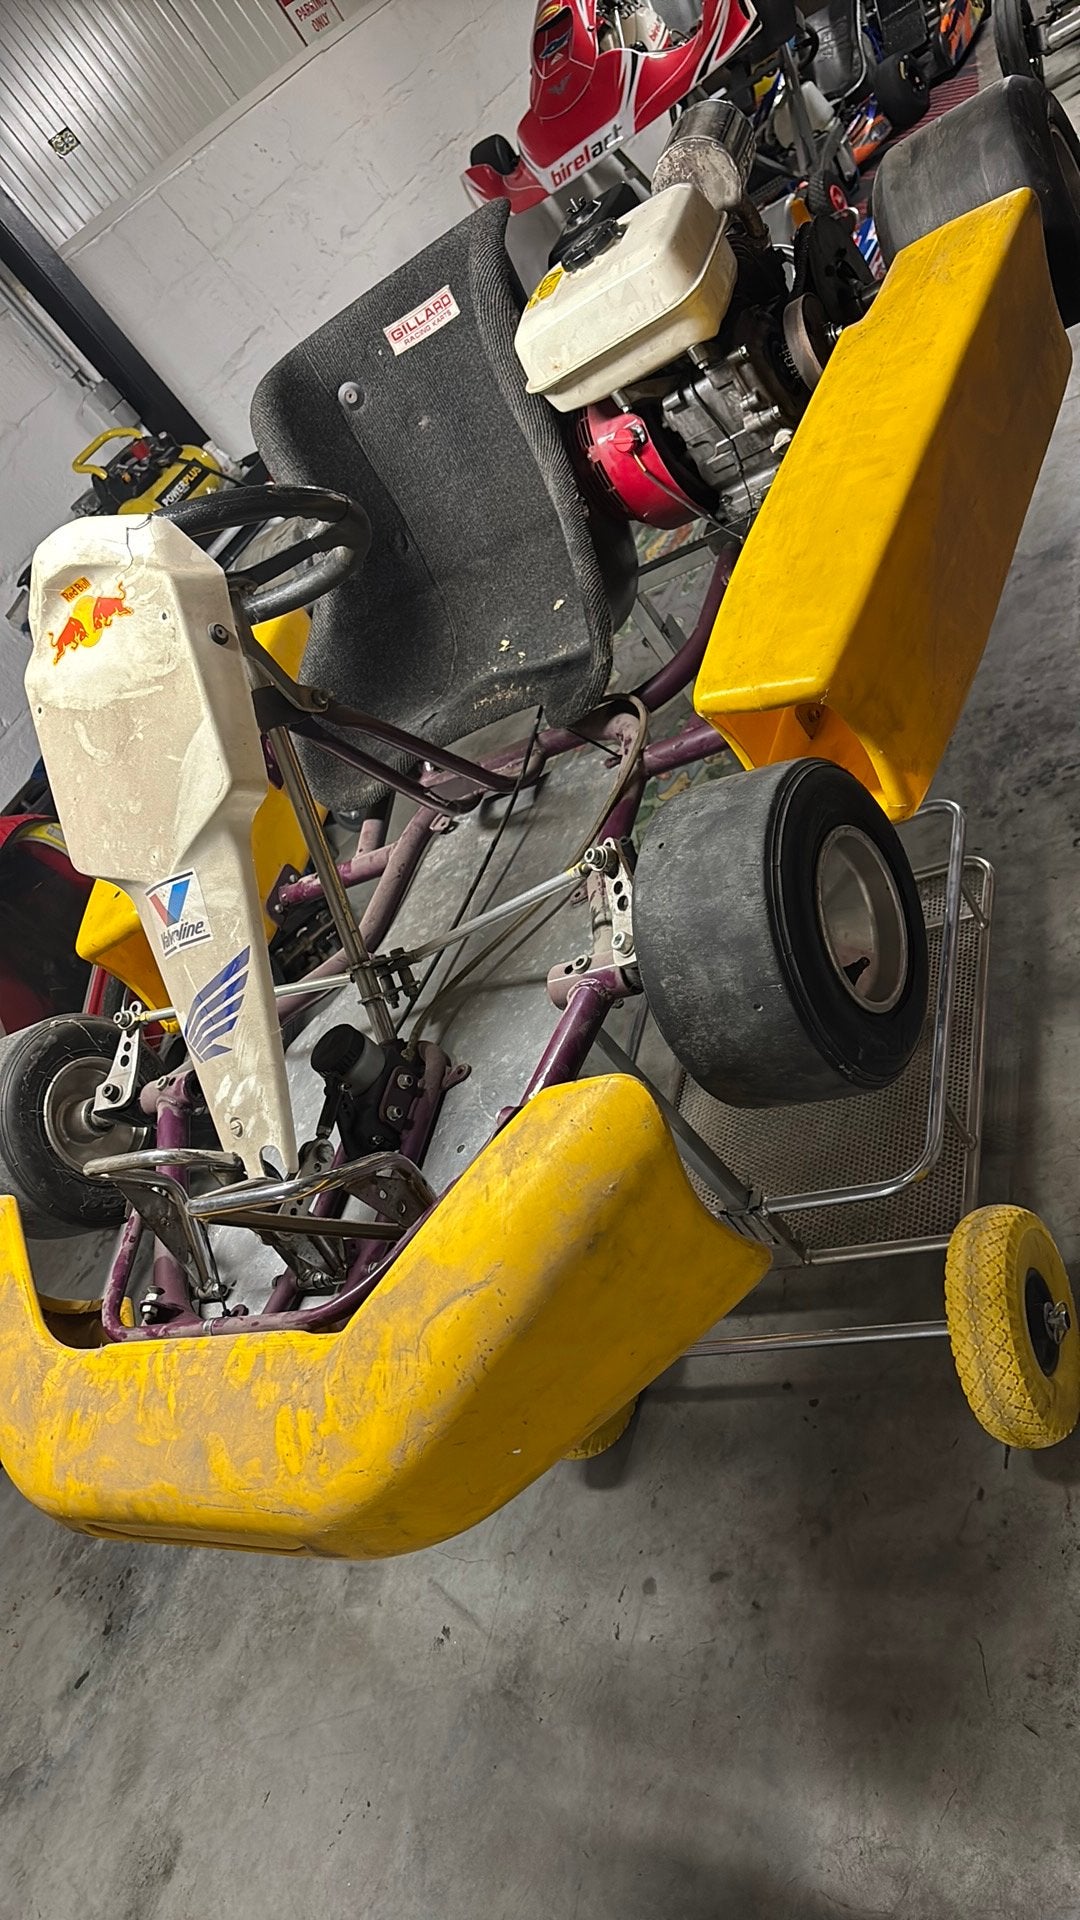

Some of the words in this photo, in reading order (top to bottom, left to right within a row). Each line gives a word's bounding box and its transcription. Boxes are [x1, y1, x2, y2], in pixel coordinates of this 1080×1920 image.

[311, 12, 330, 32] ONLY
[390, 293, 452, 342] GILLARD
[403, 325, 431, 346] RACING
[431, 309, 452, 327] KARTS
[61, 583, 78, 602] Red
[75, 577, 92, 593] Bull
